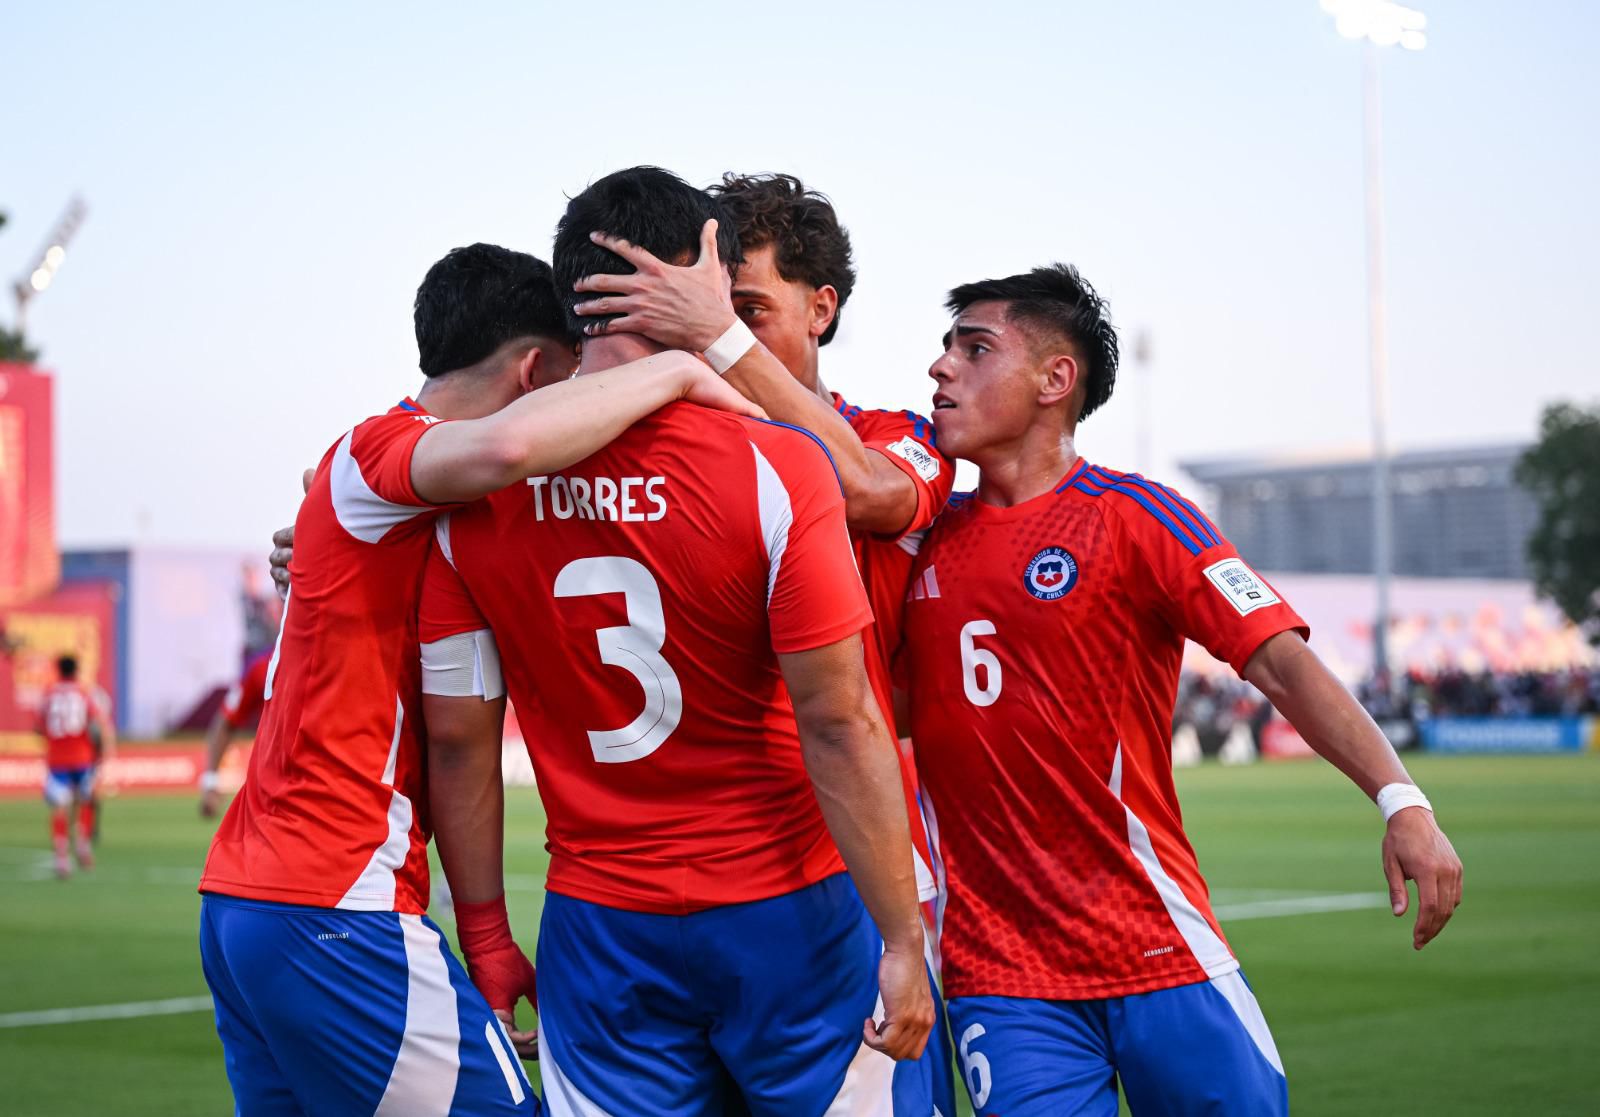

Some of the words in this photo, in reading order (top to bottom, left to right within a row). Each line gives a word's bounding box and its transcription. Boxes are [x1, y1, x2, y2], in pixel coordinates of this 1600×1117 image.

[527, 475, 667, 522] TORRES
[1035, 590, 1043, 599] DE
[1047, 590, 1064, 599] CHILE
[1226, 573, 1252, 586] UNITES
[553, 556, 683, 764] 3
[960, 619, 1003, 707] 6
[1144, 946, 1173, 957] AEROREADY
[960, 1022, 992, 1110] 6
